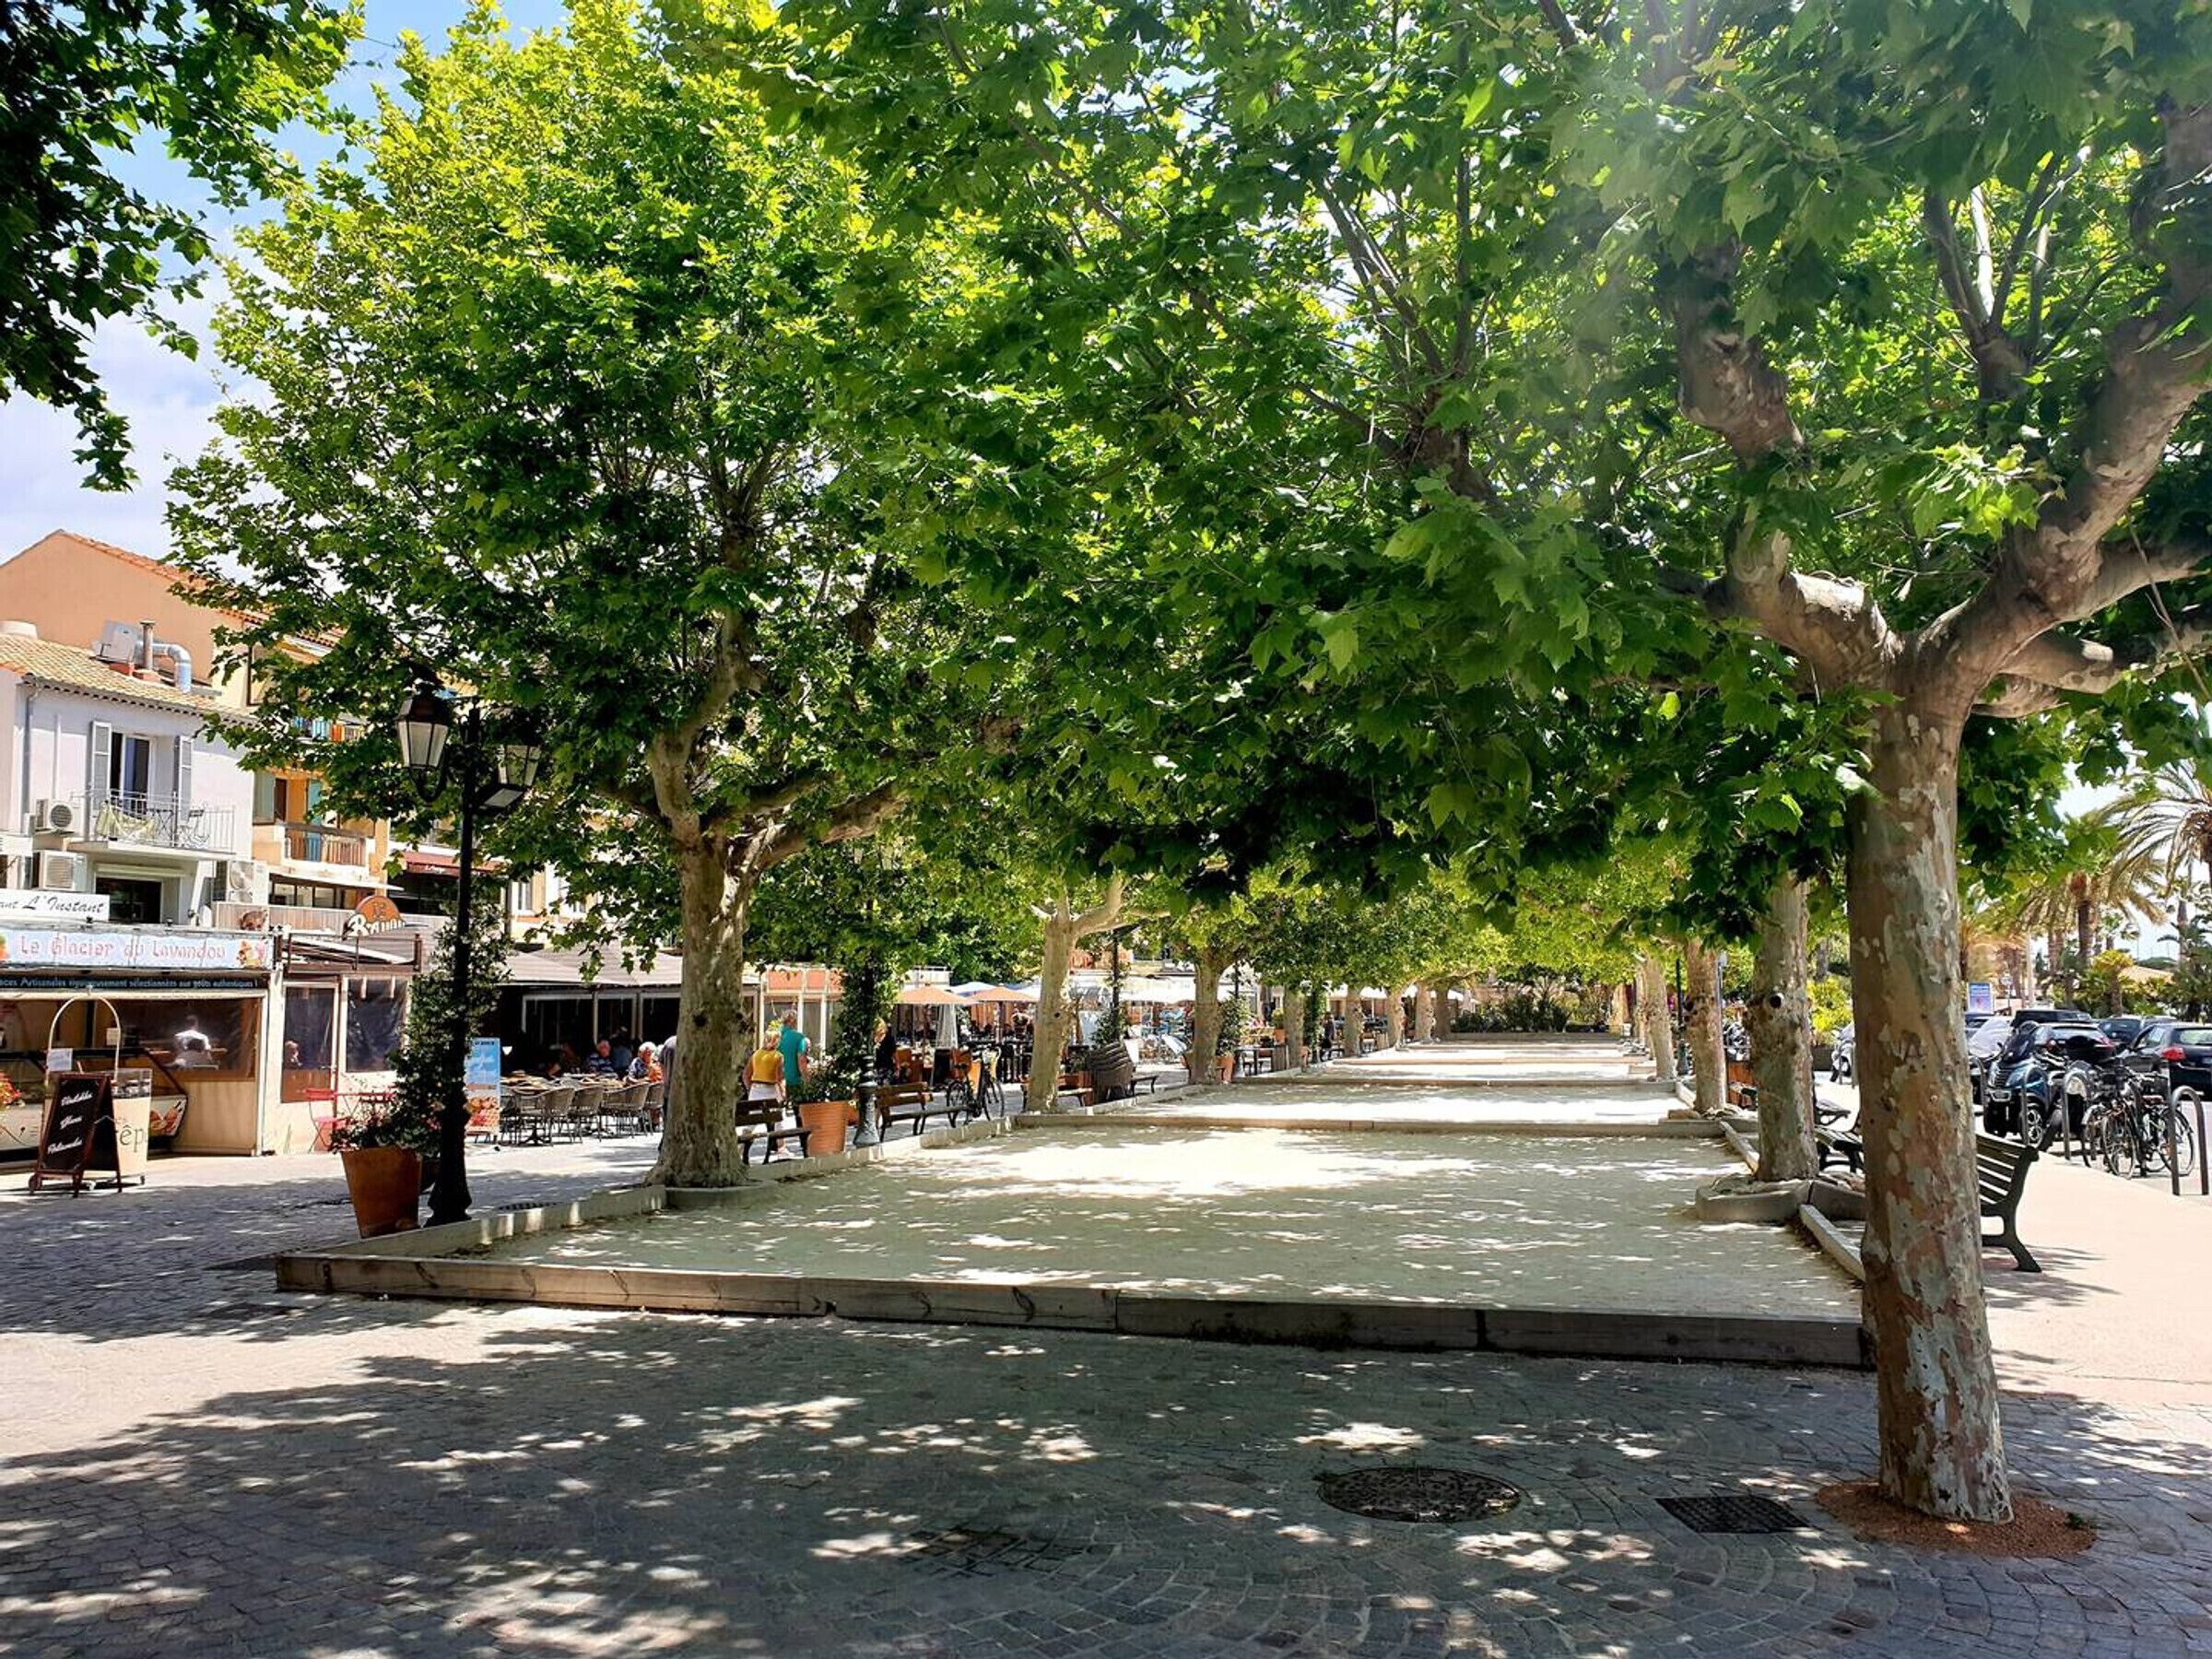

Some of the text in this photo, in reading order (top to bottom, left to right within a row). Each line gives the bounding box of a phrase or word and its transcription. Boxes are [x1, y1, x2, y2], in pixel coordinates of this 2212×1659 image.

[0, 900, 18, 910] ant
[20, 935, 226, 960] Le Glacier du Lavandou
